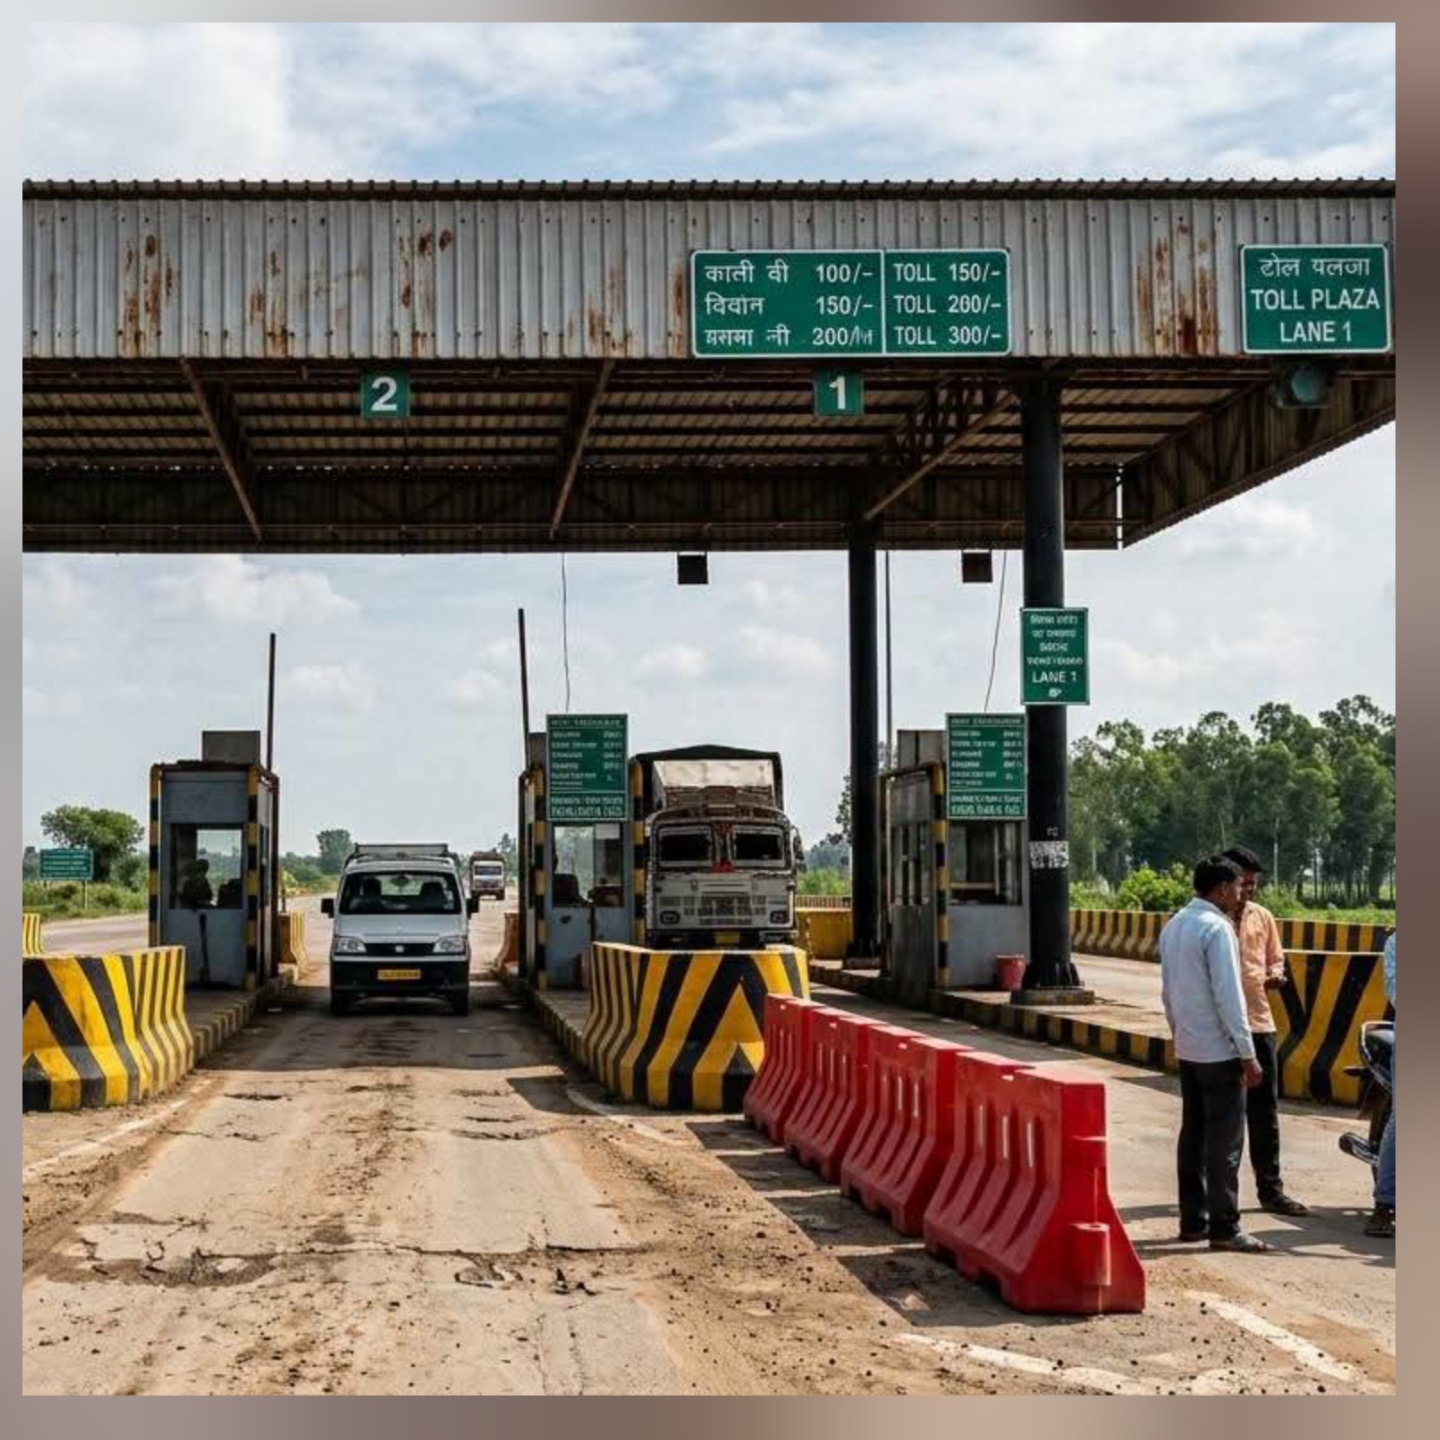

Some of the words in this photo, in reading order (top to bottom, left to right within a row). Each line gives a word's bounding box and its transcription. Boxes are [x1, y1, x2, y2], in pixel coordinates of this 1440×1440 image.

[815, 263, 874, 284] 100/-
[894, 262, 937, 282] TOLL
[948, 262, 1001, 283] 150/-
[1258, 252, 1301, 277] टोल
[815, 294, 874, 316] 150/-
[893, 294, 937, 314] TOLL
[1250, 288, 1305, 310] TOLL
[1311, 287, 1381, 310] PLAZA
[894, 325, 937, 345] TOLL
[948, 324, 1002, 345] 300/-
[1280, 320, 1337, 343] LANE
[1342, 320, 1353, 343] 1
[371, 376, 397, 411] 2
[829, 375, 846, 410] 1
[1032, 670, 1067, 683] LANE
[1070, 670, 1077, 682] 1
